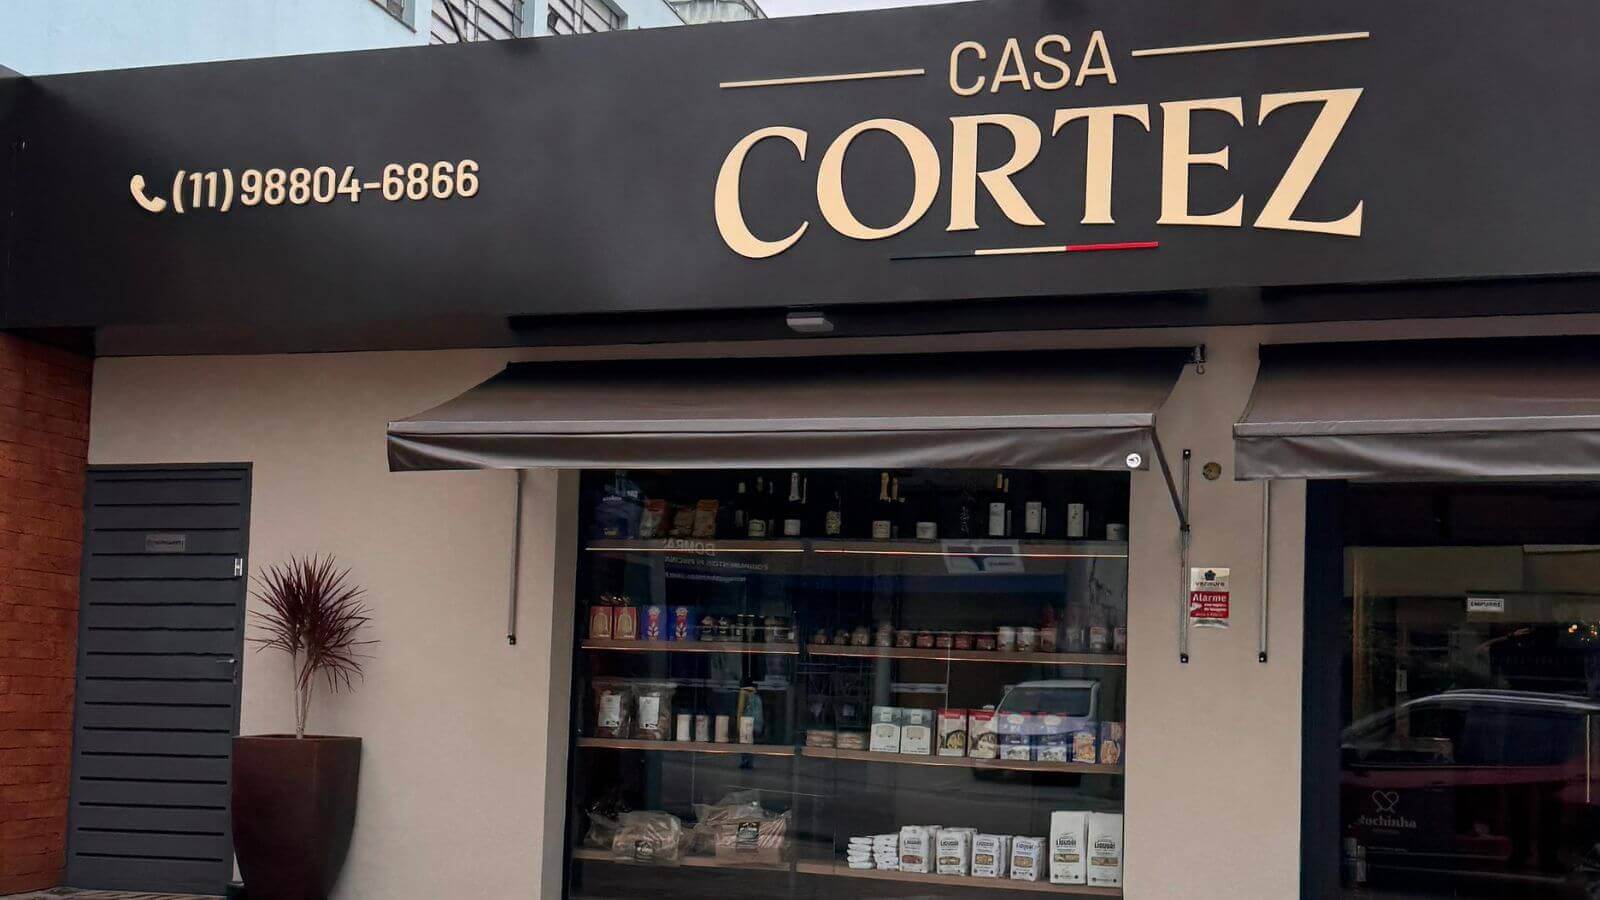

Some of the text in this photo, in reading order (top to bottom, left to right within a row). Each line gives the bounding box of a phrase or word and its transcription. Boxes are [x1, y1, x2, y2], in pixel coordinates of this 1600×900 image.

[949, 30, 1118, 97] CASA
[173, 159, 480, 214] (11) 98804-6866
[714, 87, 1364, 258] CORTEZ
[1192, 593, 1227, 603] Alarme
